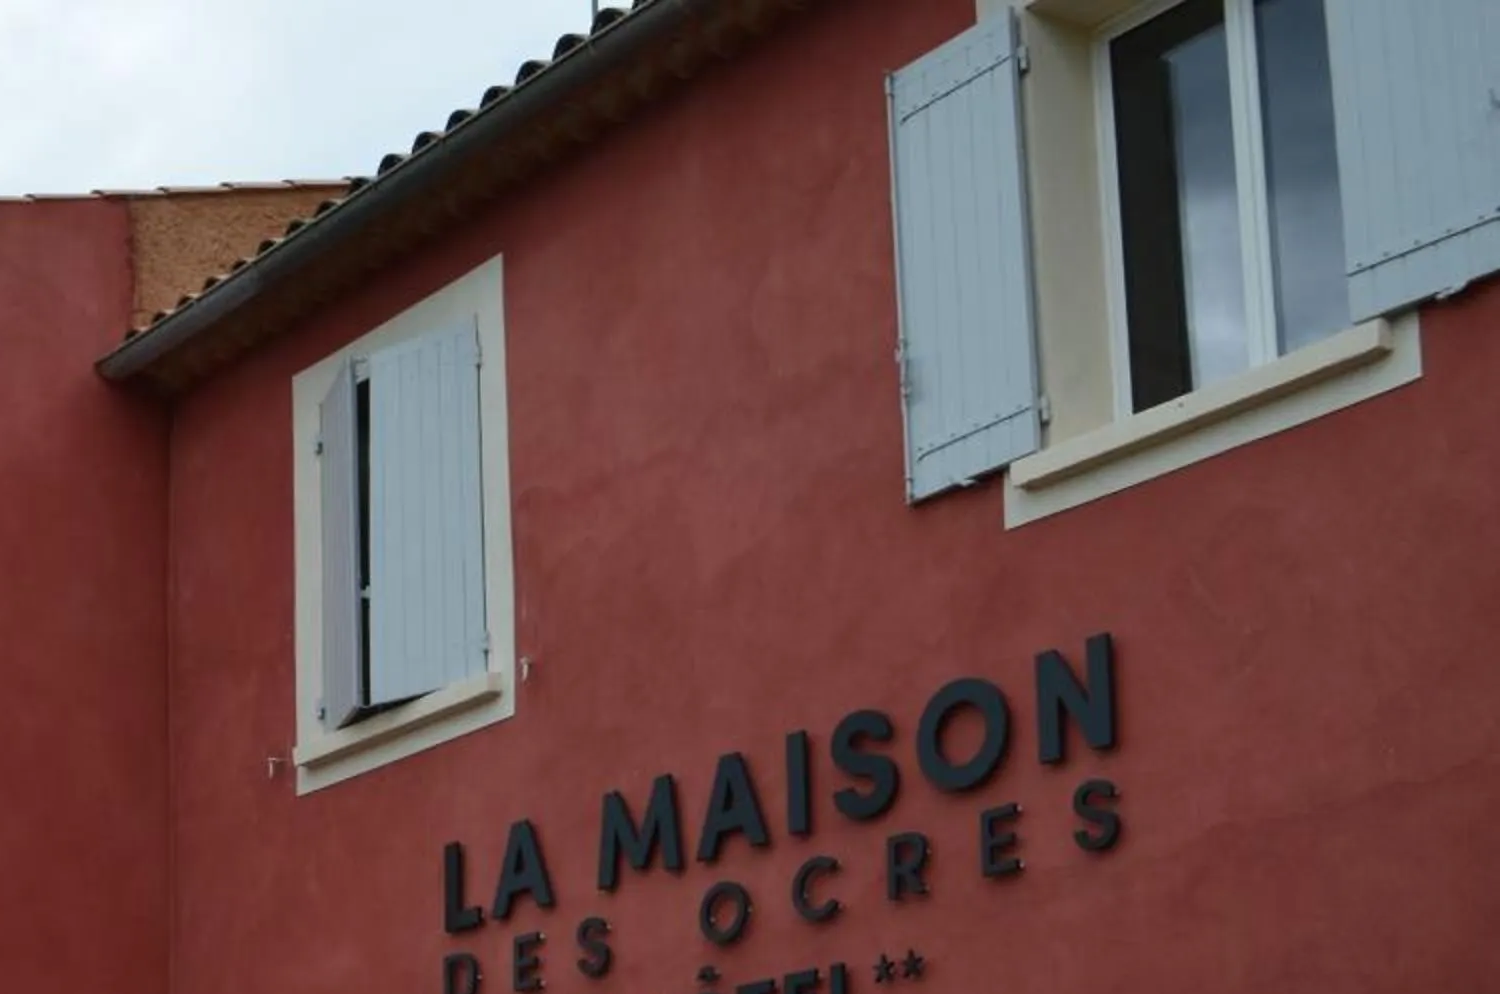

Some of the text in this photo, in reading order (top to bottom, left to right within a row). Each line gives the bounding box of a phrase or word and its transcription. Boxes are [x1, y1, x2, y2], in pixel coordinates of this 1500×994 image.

[443, 633, 1118, 934] LA MAISON
[700, 779, 1121, 946] OCRES
